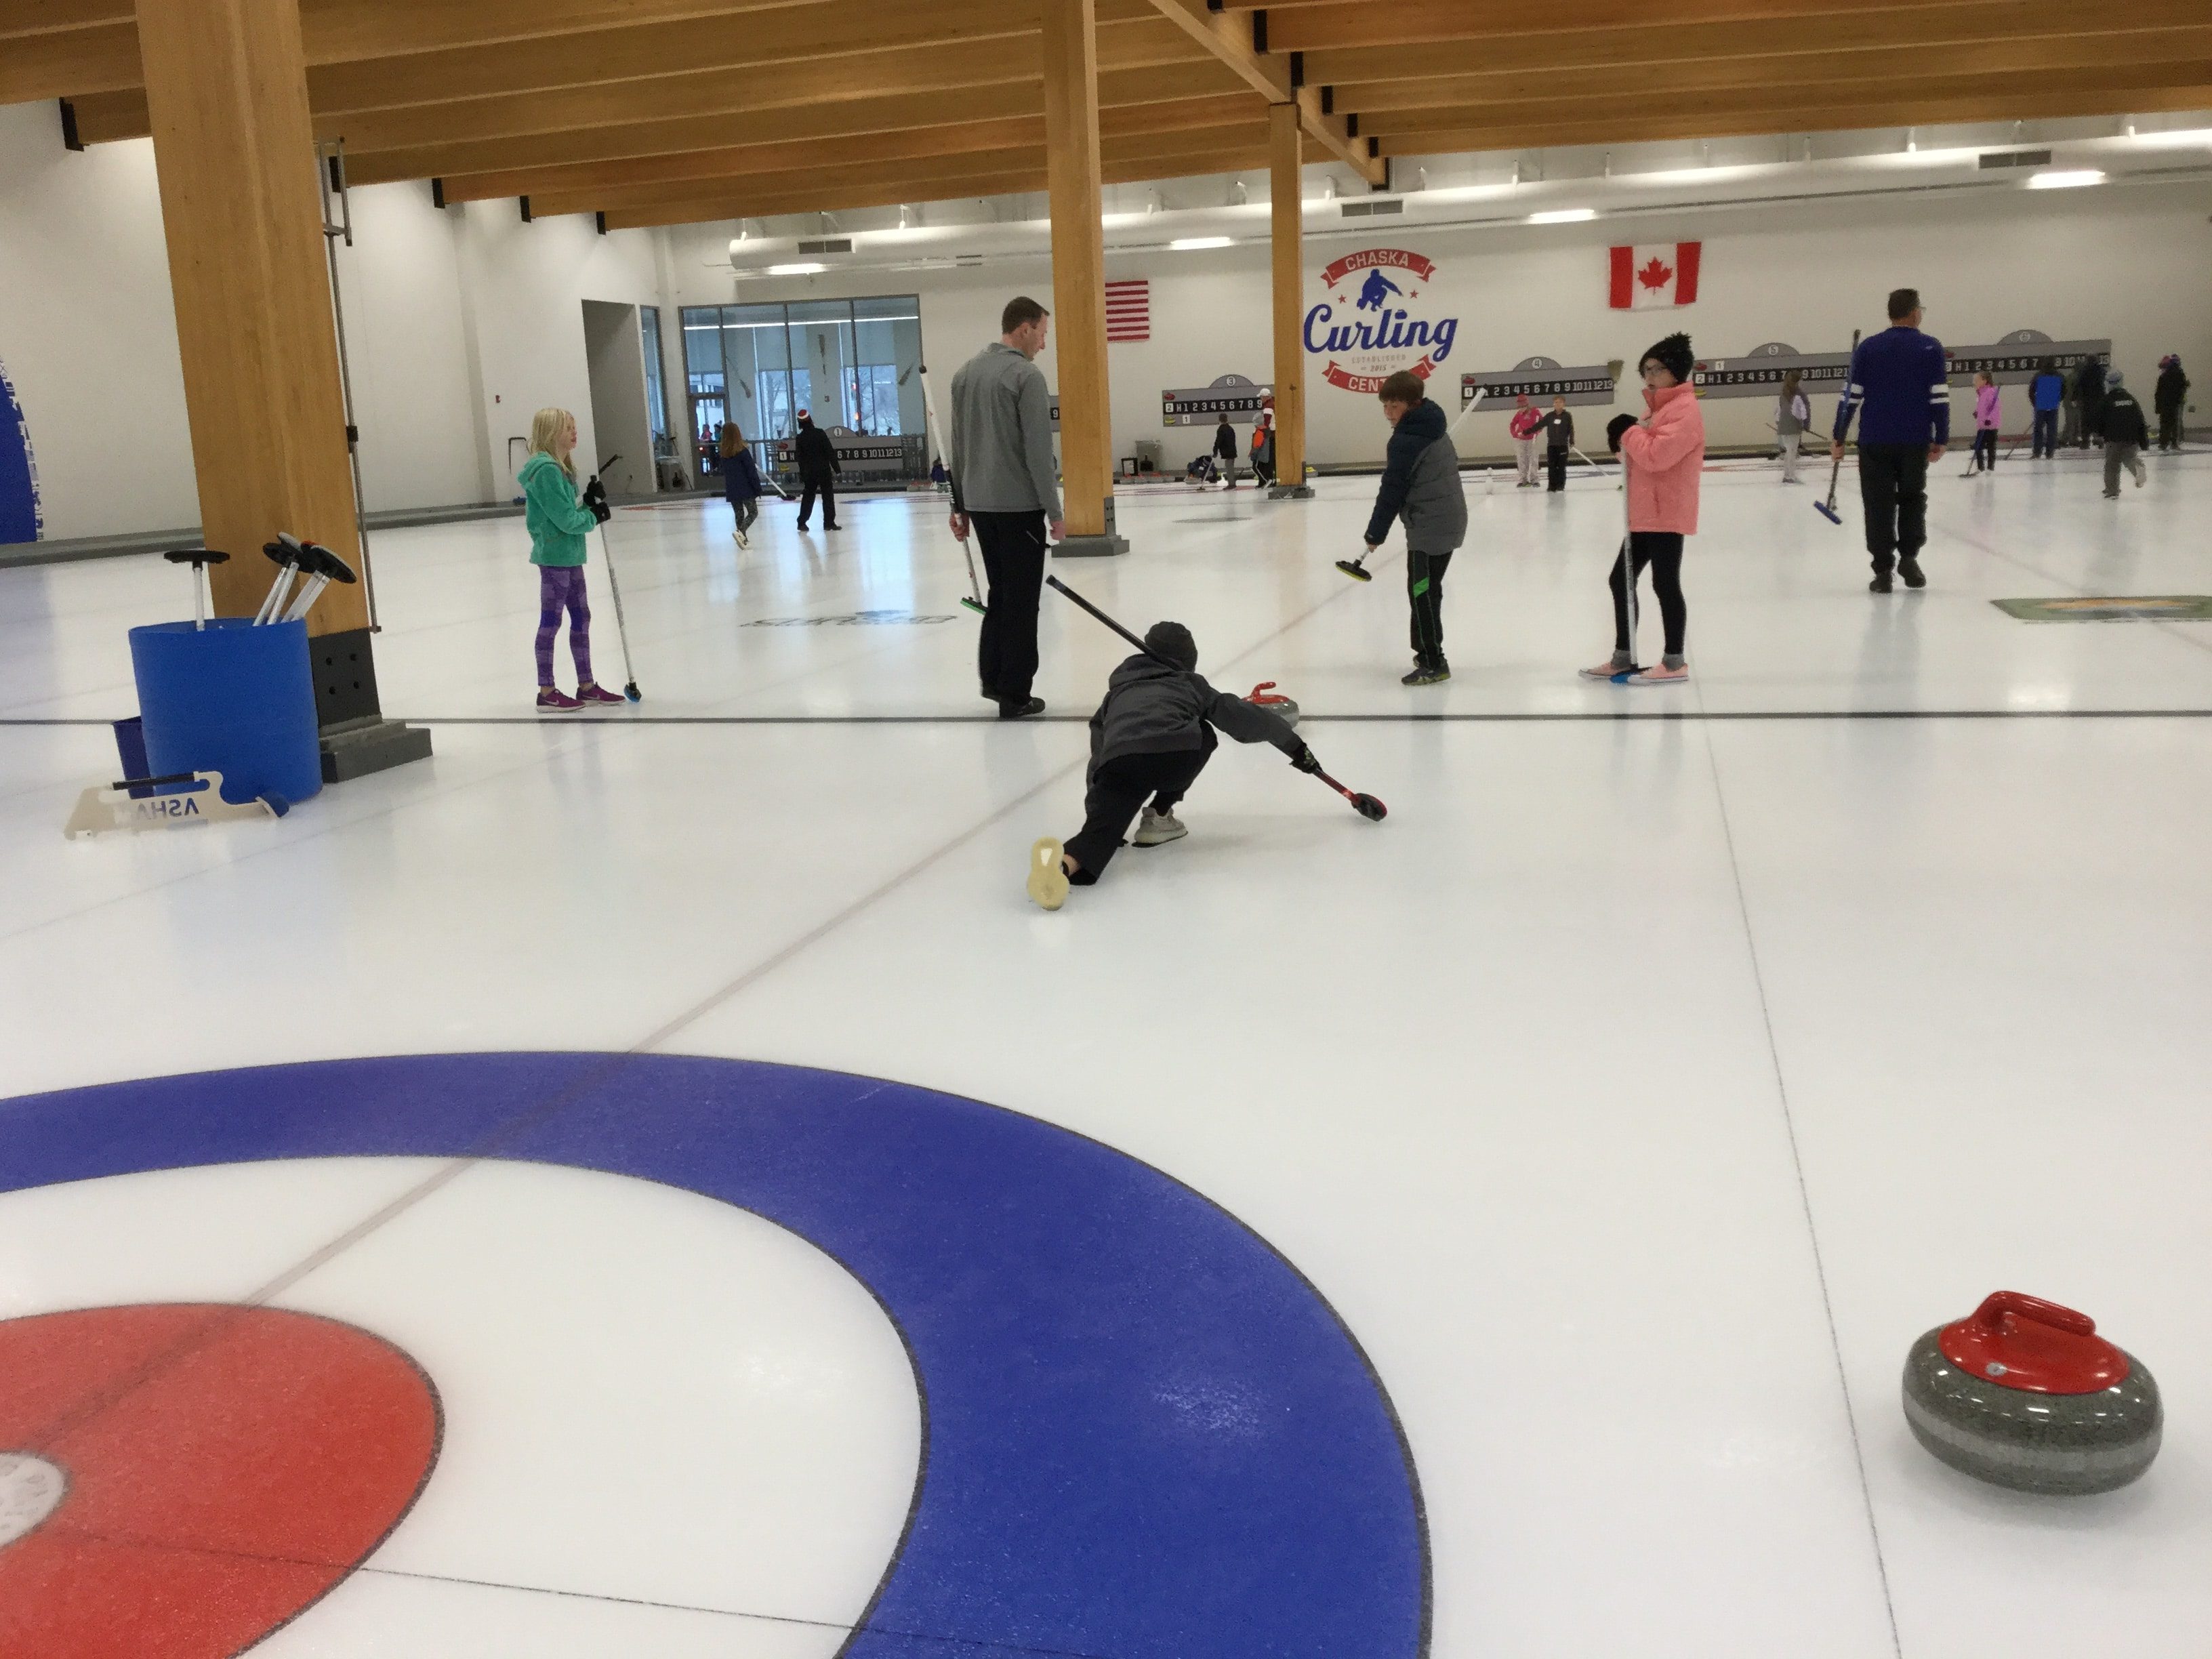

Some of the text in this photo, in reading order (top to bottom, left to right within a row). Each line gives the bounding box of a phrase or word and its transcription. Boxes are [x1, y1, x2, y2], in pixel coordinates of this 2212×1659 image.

[1345, 250, 1409, 270] CHASKA
[1304, 304, 1458, 362] Curling
[1727, 375, 1733, 383] 2
[1738, 373, 1744, 382] 3
[1748, 373, 1755, 381] 4
[1759, 372, 1765, 381] 5
[1770, 372, 1776, 380] 6
[1781, 371, 1786, 380] 7
[1802, 369, 1809, 378] 9
[1811, 369, 1821, 378] 10
[1822, 368, 1831, 377] 11
[1833, 368, 1843, 377] 12
[1349, 377, 1385, 391] CEN
[1534, 385, 1540, 393] 6
[1544, 384, 1549, 392] 7
[1554, 384, 1560, 392] 8
[1565, 383, 1571, 391] 9
[1573, 382, 1582, 391] 10
[1584, 382, 1592, 390] 11
[1594, 381, 1603, 390] 12
[1604, 380, 1613, 389] 13
[1193, 403, 1197, 411] 2
[1202, 403, 1207, 411] 3
[1211, 402, 1216, 410] 4
[1229, 401, 1234, 409] 6
[1239, 401, 1244, 409] 7
[1257, 400, 1262, 408] 9
[1053, 409, 1059, 418] 9
[781, 452, 785, 460] 1
[838, 451, 842, 459] 6
[846, 450, 851, 458] 7
[854, 449, 859, 458] 8
[862, 449, 867, 458] 9
[869, 449, 878, 457] 10
[878, 449, 886, 457] 11
[886, 449, 894, 457] 12
[895, 449, 902, 457] 13
